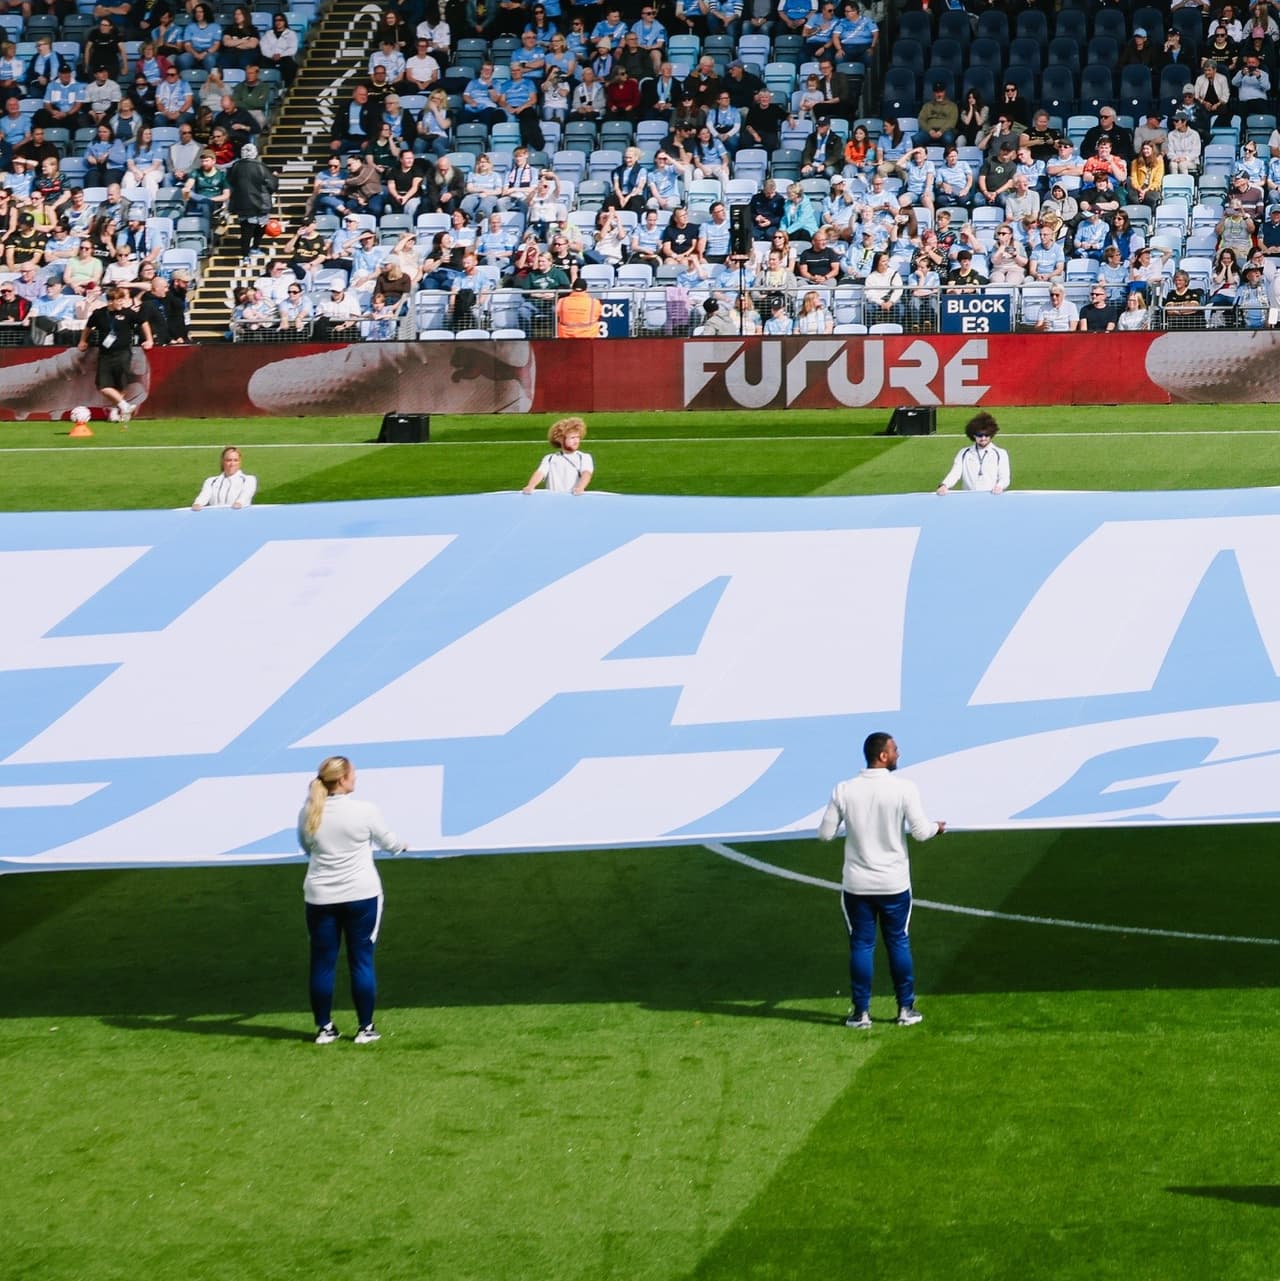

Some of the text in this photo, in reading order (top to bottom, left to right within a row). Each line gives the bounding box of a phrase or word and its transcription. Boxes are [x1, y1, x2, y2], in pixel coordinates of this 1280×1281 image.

[947, 299, 1006, 313] BLOCK
[962, 316, 990, 333] E3
[683, 339, 990, 409] FUTURE
